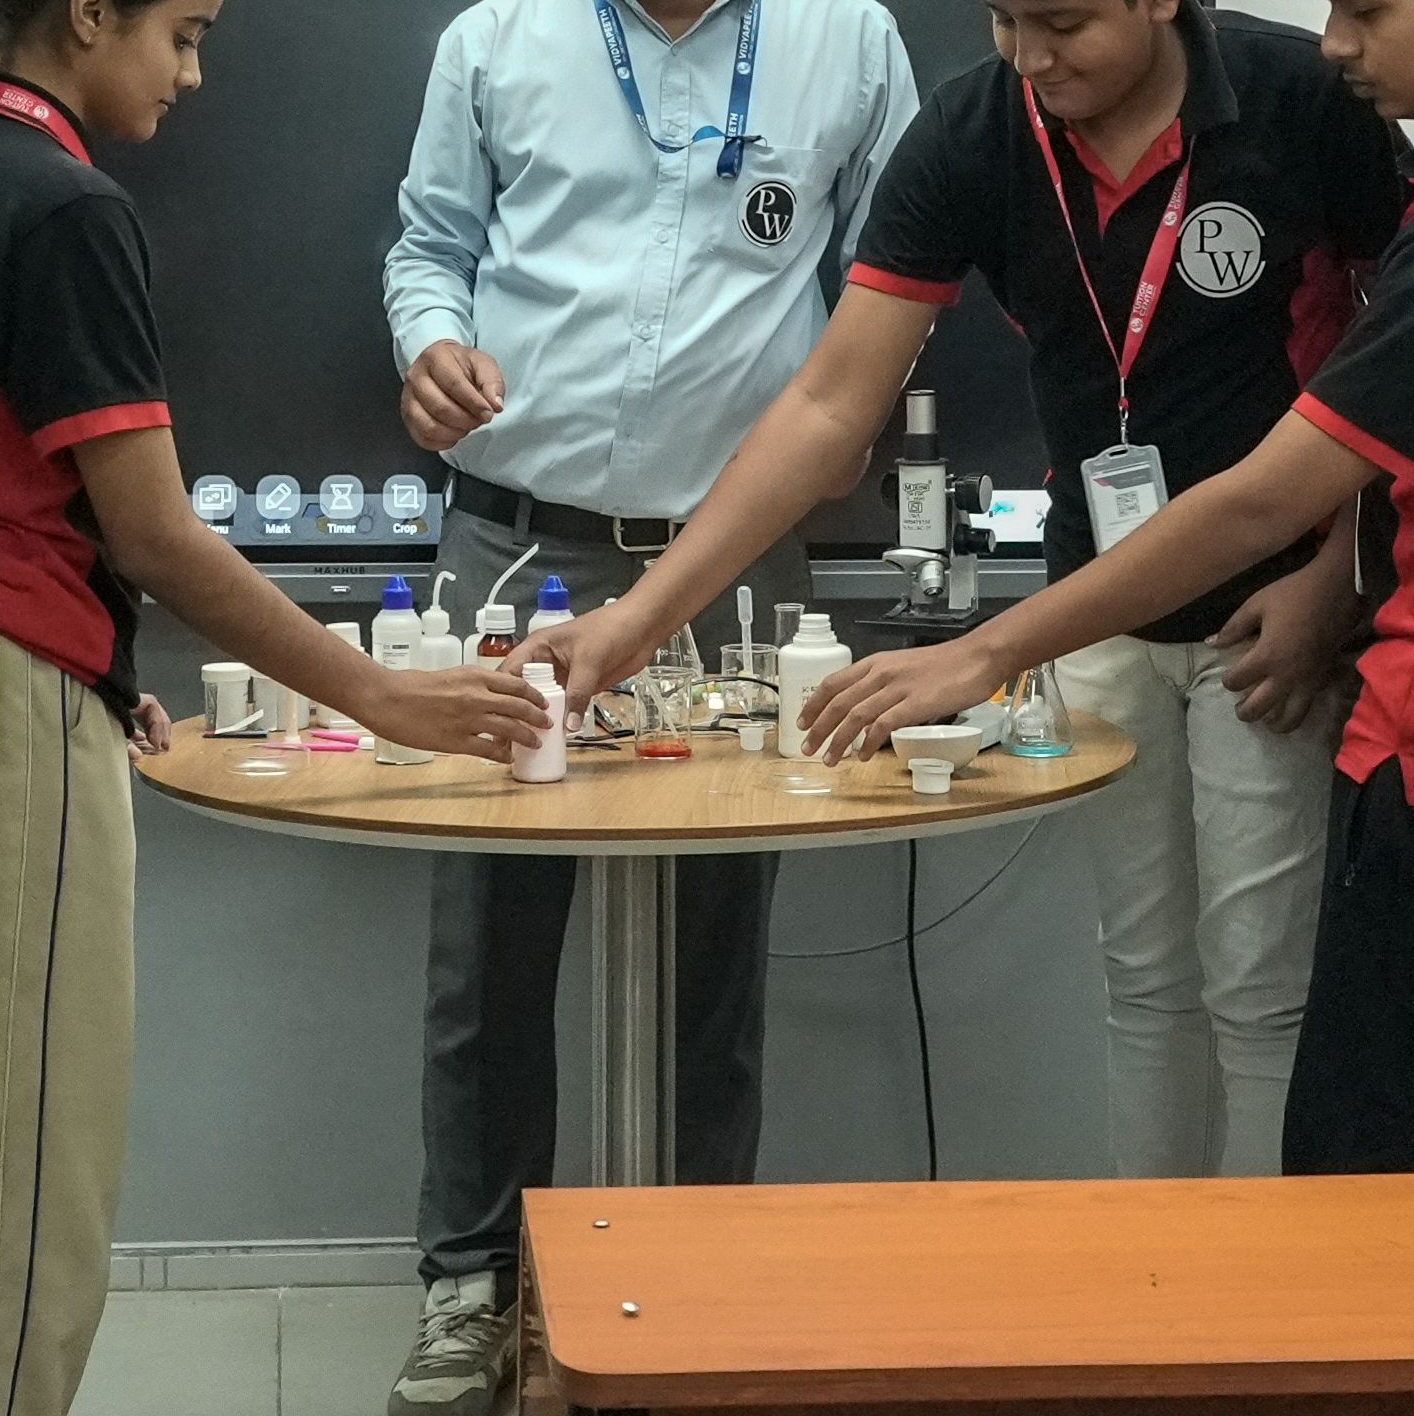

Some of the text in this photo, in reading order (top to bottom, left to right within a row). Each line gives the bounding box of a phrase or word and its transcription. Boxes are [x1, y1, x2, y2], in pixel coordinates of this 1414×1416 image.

[598, 8, 623, 67] VIDYAPEETH
[738, 5, 755, 60] VIDYAPEE
[1194, 219, 1254, 287] PW
[207, 522, 418, 537] enu Mark Timer Crop
[313, 566, 366, 575] MAXHUB
